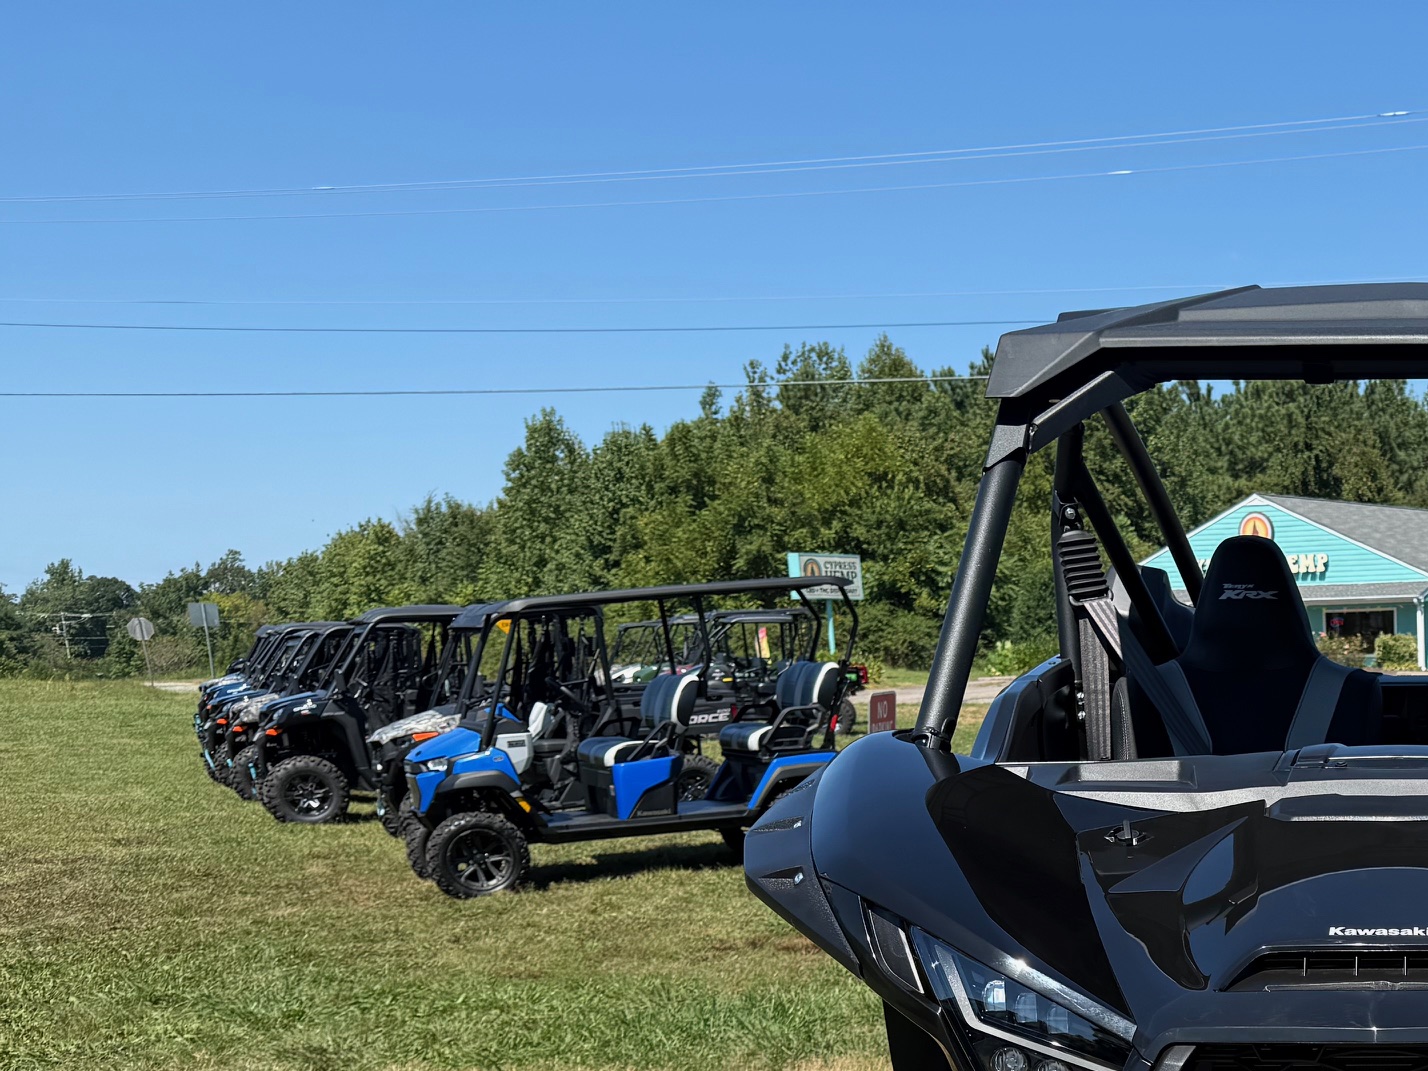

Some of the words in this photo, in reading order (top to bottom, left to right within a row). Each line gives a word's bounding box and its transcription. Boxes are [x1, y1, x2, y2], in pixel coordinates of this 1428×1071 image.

[823, 561, 857, 570] CYPRESS
[1287, 553, 1328, 574] EMP
[1219, 590, 1278, 600] KRX
[877, 700, 888, 719] NO
[689, 713, 730, 724] ORCE
